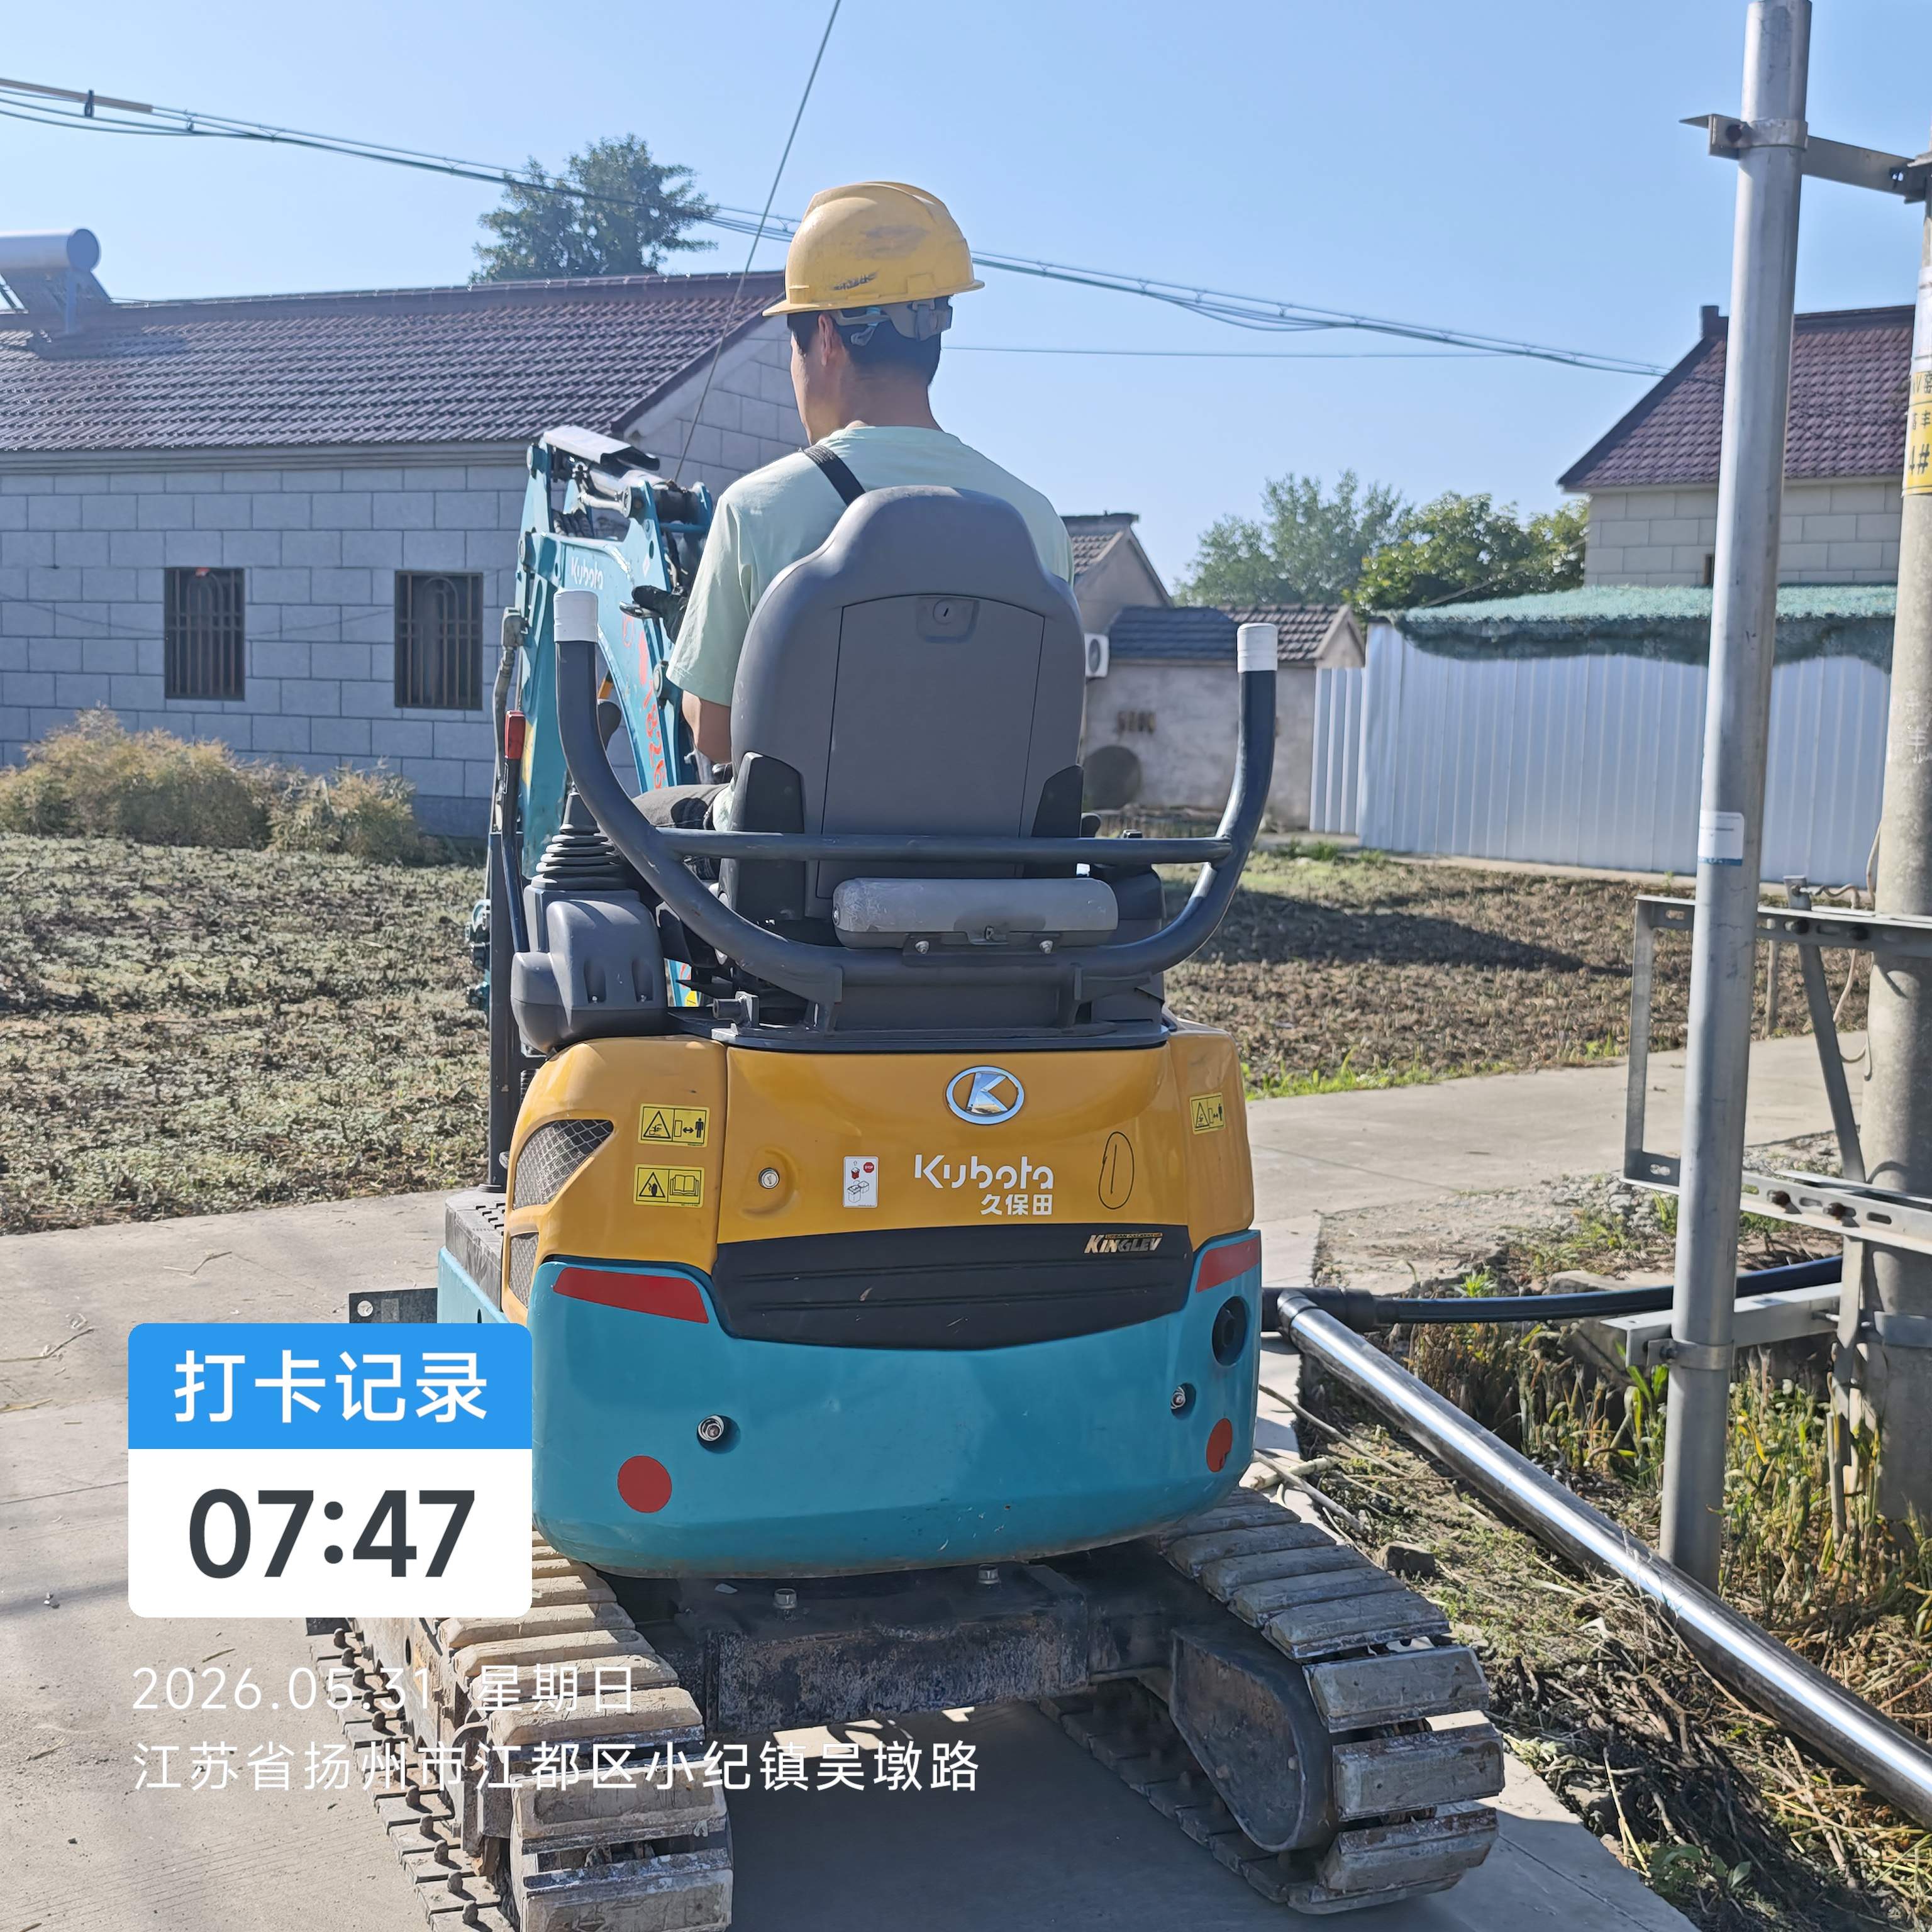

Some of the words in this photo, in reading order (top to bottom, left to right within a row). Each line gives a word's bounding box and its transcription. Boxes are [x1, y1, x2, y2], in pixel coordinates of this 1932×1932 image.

[571, 557, 604, 590] Kubota
[914, 1154, 1054, 1189] Kubota
[980, 1194, 1053, 1215] 久保田
[1084, 1234, 1162, 1253] KINGLEV
